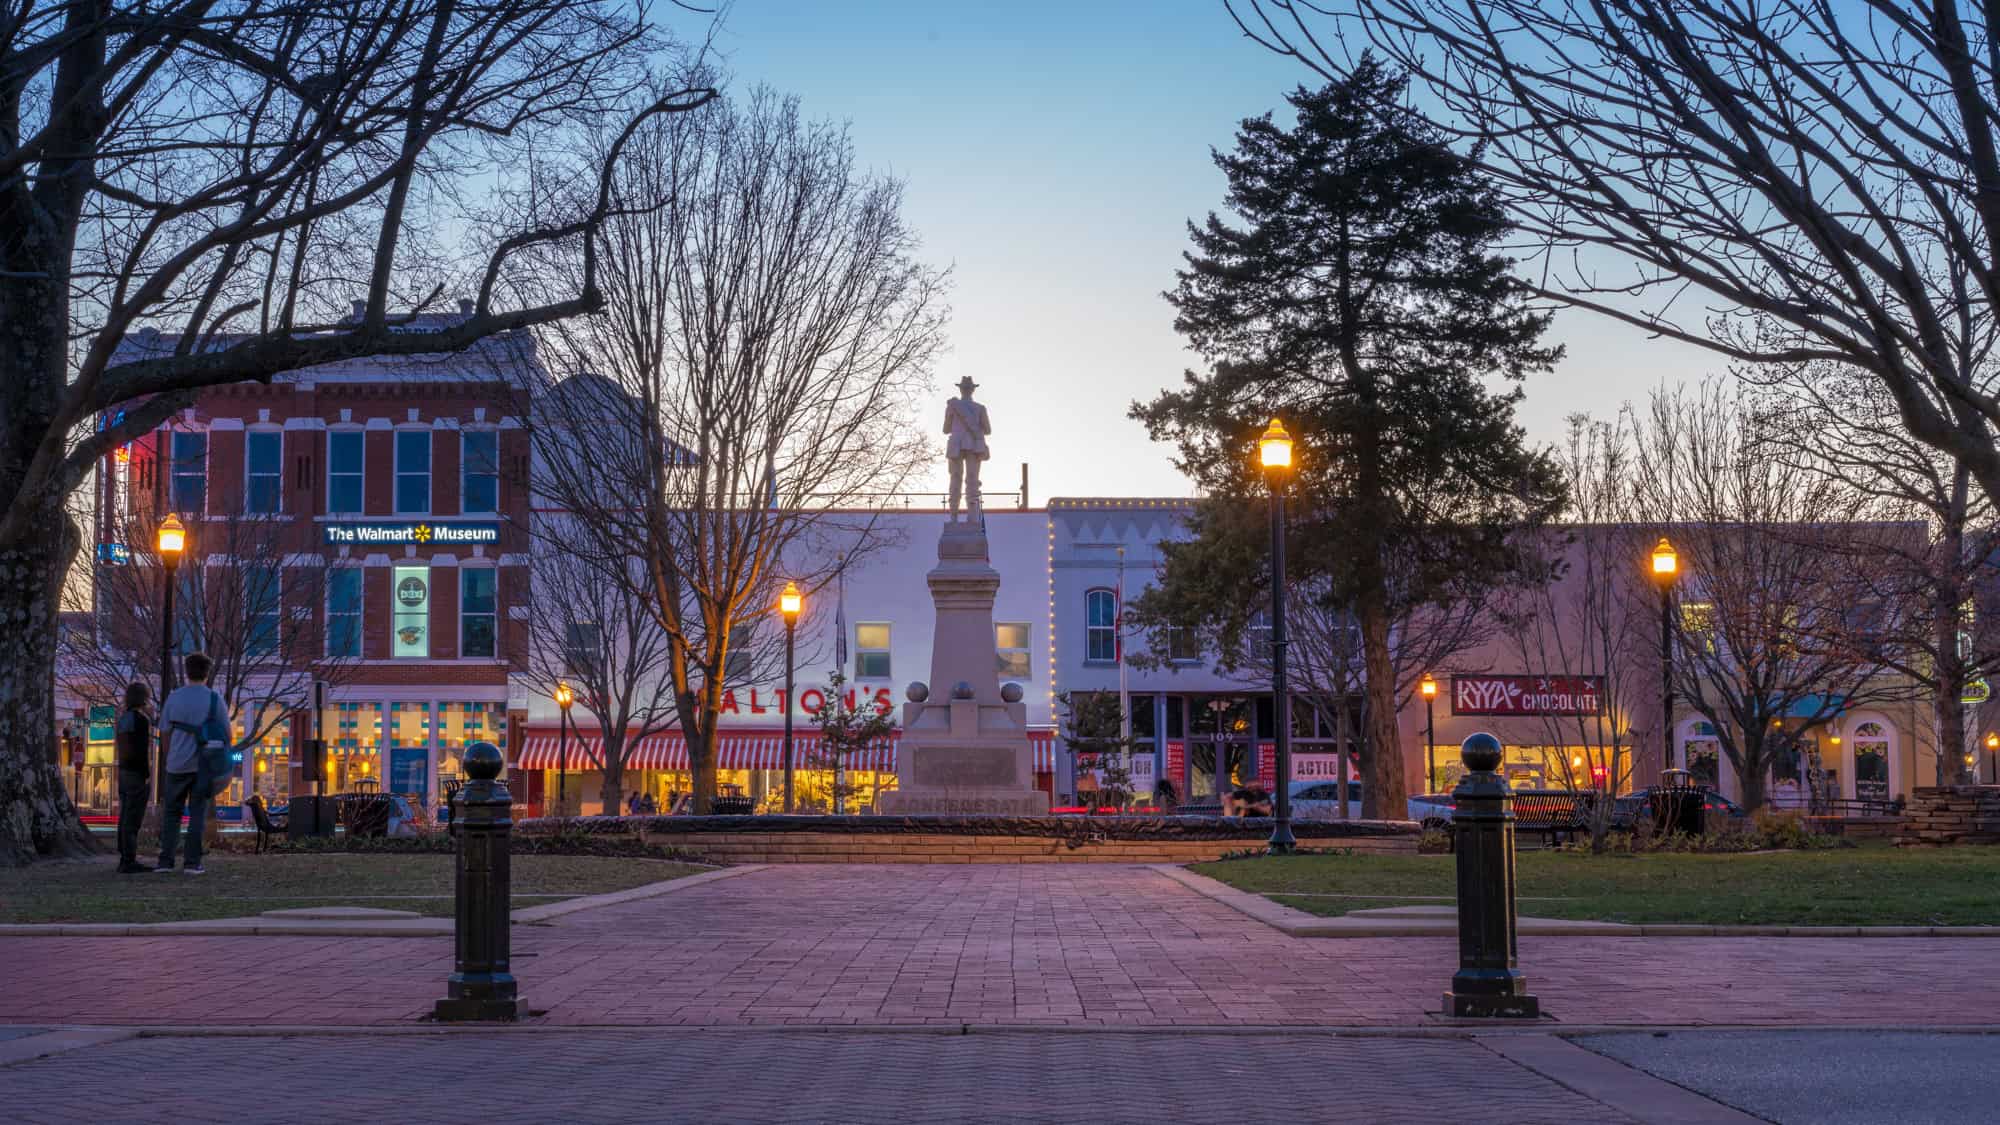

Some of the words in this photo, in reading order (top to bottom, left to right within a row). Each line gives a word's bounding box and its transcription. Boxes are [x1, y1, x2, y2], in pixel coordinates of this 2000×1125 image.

[327, 527, 354, 540] The
[357, 527, 413, 540] Walmart
[434, 527, 496, 540] Museum
[1522, 694, 1599, 711] CHOCOLATE
[1210, 732, 1233, 743] 109
